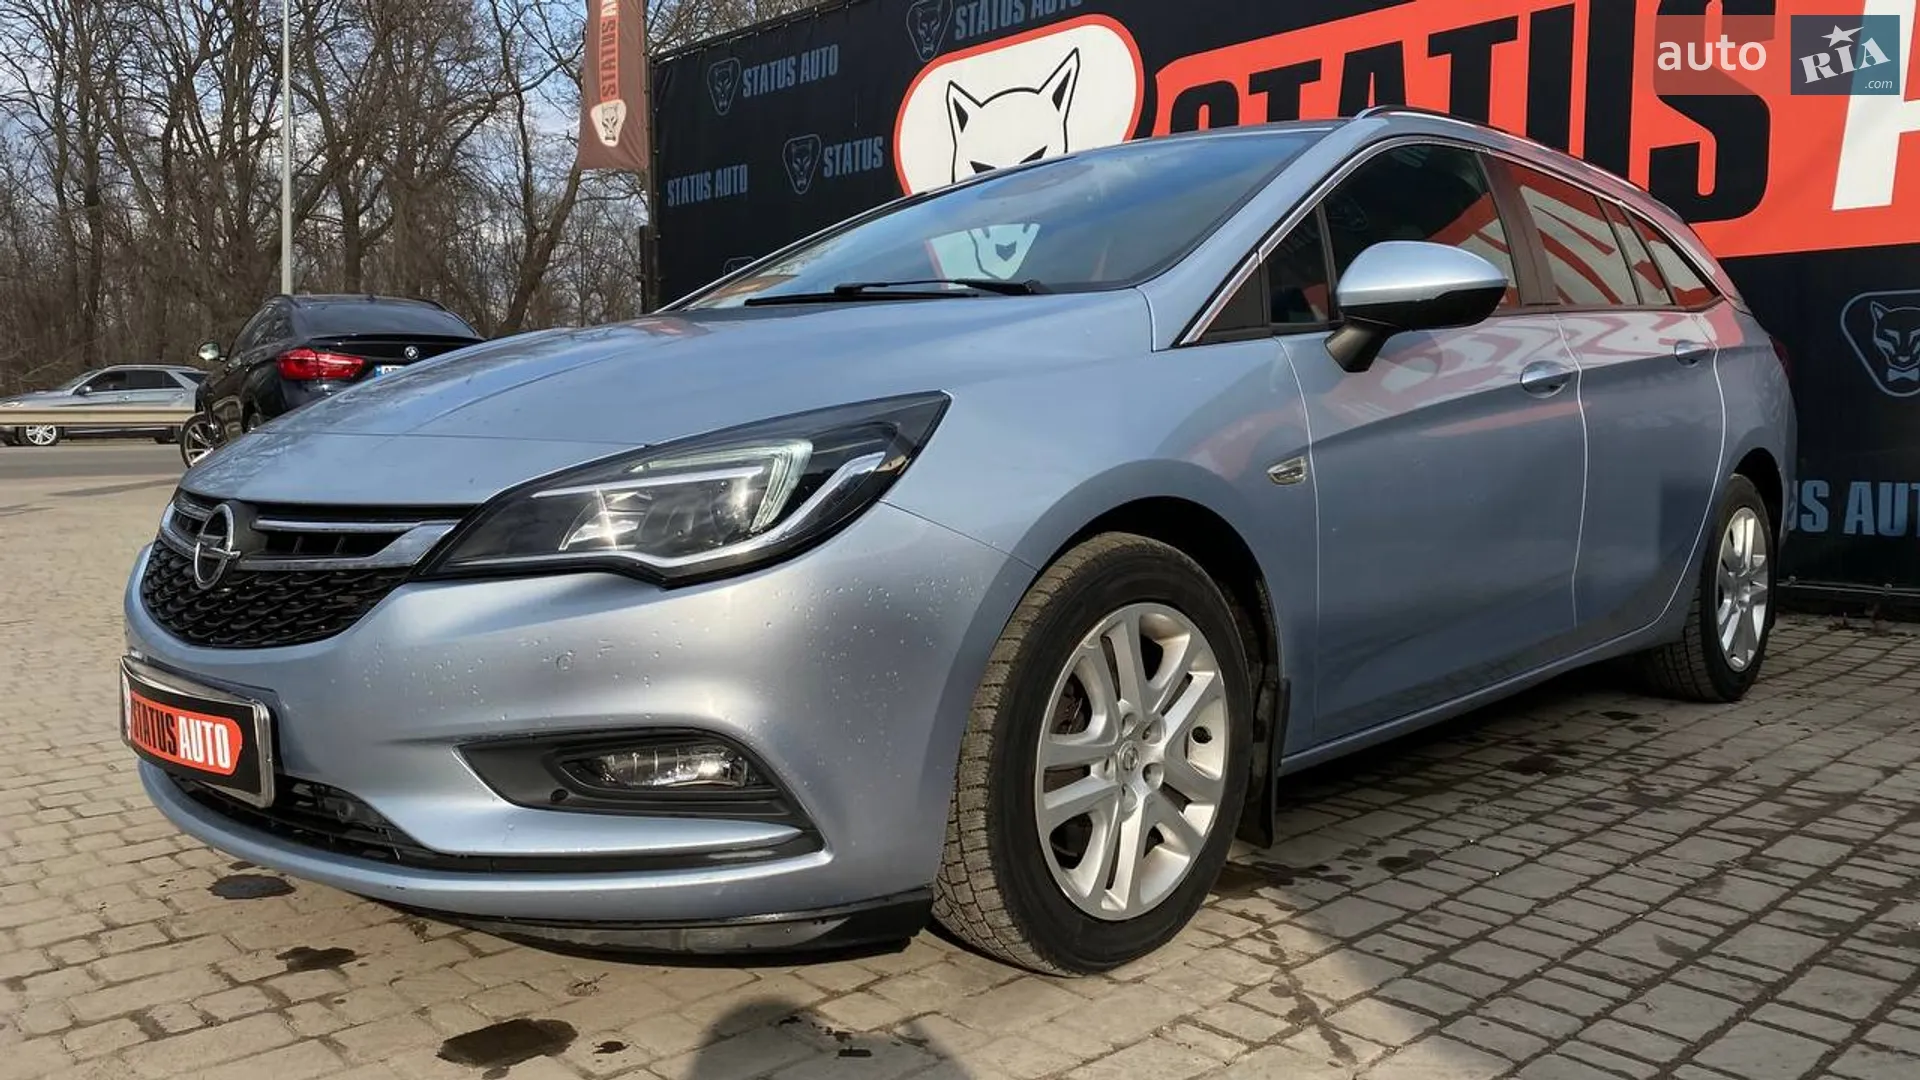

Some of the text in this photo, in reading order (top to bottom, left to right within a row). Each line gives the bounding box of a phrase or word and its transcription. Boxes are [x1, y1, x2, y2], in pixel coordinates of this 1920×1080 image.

[954, 0, 1082, 41] STATUS AU
[600, 19, 617, 97] STATUS
[742, 43, 839, 98] STATUS AUTO
[1171, 0, 1771, 224] TUS
[822, 136, 884, 178] STATUS
[667, 164, 748, 207] STATUS AUTO
[132, 699, 231, 769] STATUS AUTO
